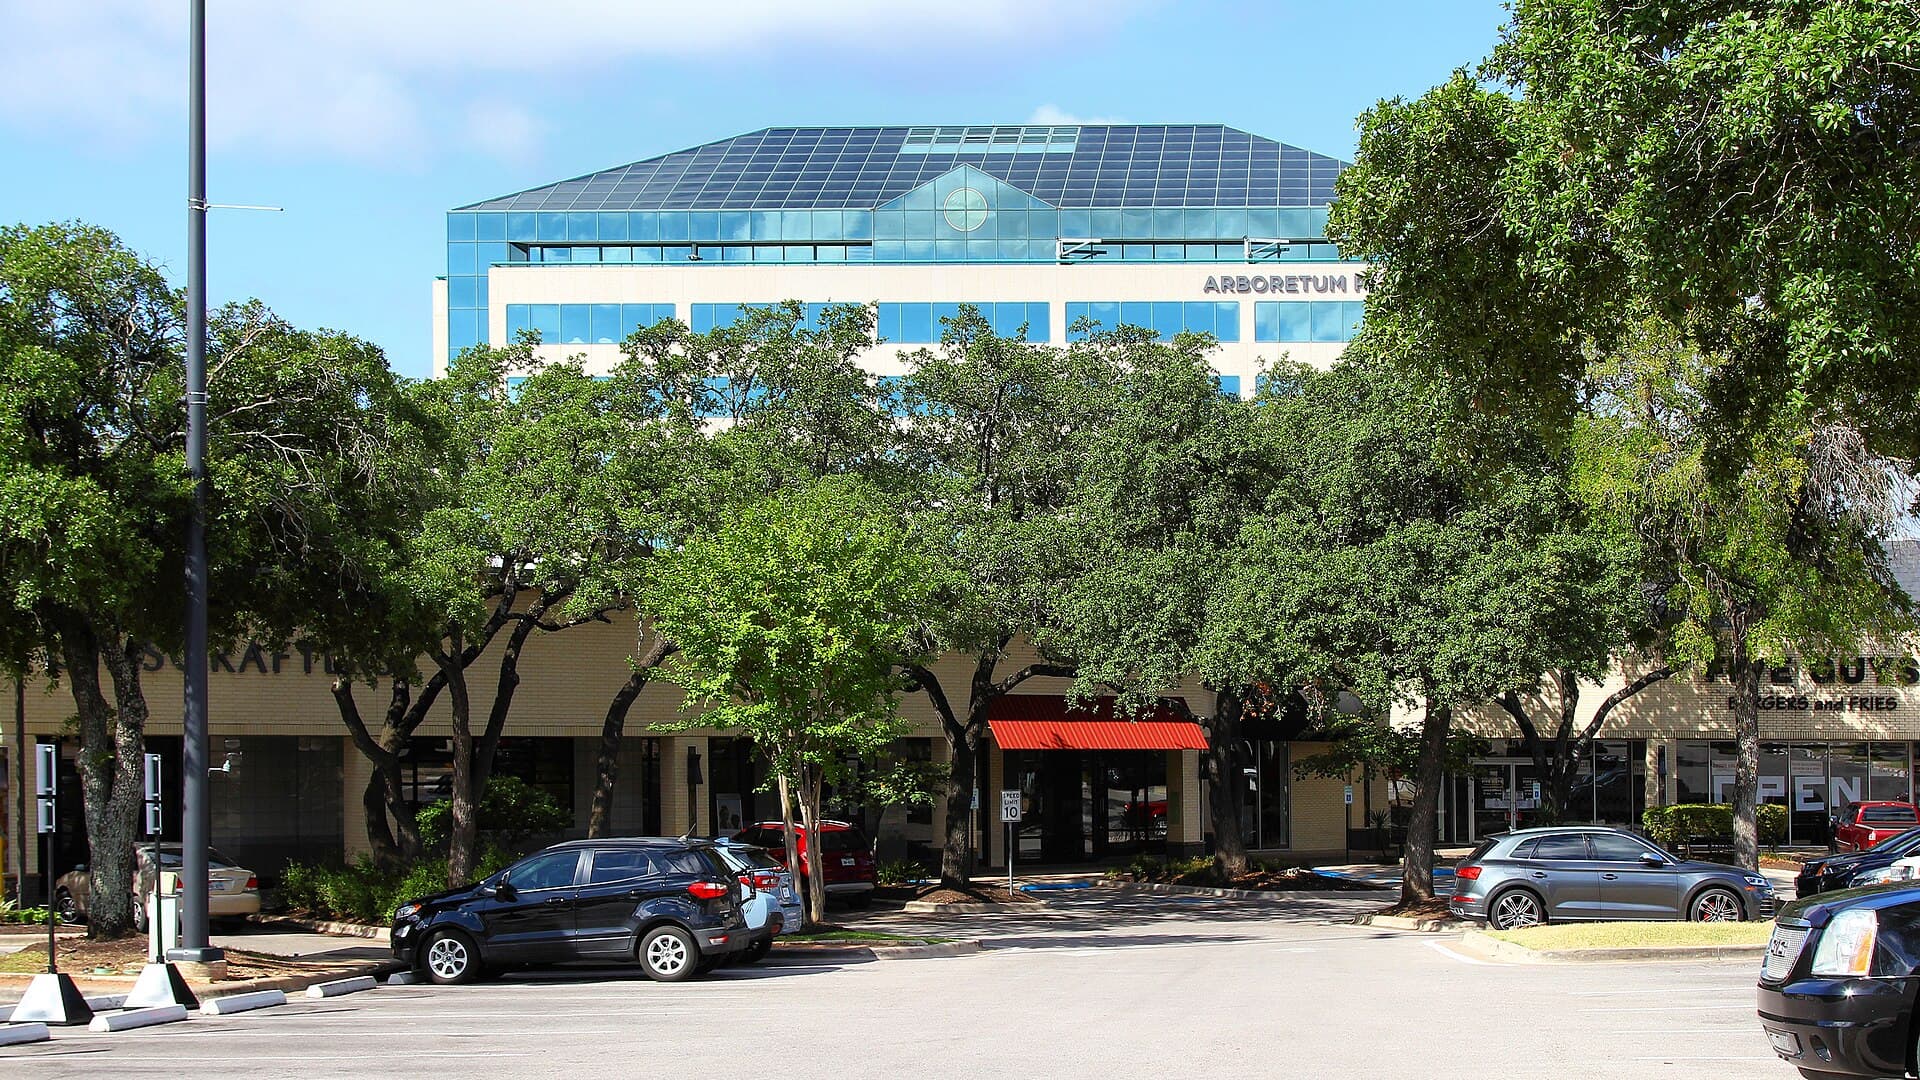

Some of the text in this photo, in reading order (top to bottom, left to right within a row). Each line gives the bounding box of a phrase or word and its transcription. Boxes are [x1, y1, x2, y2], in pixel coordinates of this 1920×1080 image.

[1204, 275, 1347, 293] ARBORETUM
[1729, 696, 1897, 711] BRGERS and FRIES
[1004, 806, 1018, 818] 10
